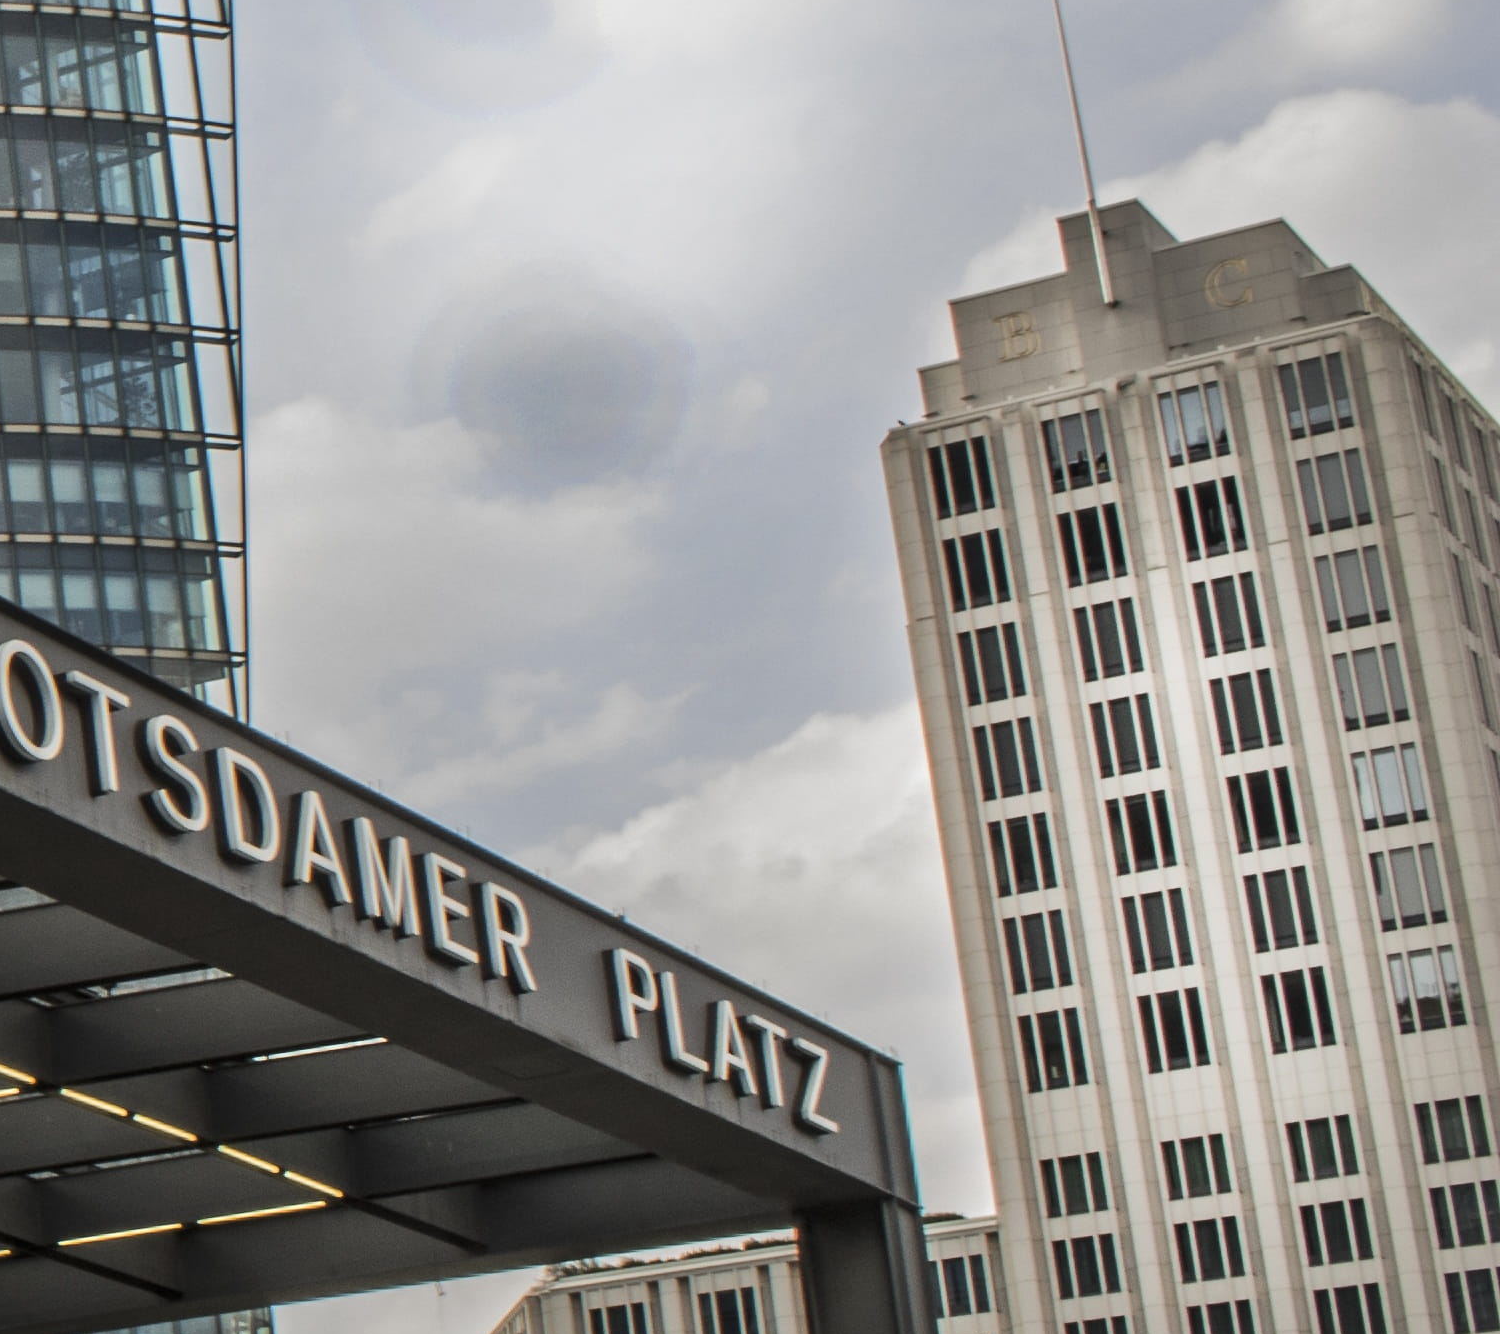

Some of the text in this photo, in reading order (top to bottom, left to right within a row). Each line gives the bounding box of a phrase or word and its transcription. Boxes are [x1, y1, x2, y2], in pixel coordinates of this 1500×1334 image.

[992, 258, 1254, 363] B C
[604, 947, 841, 1135] PLATZ
